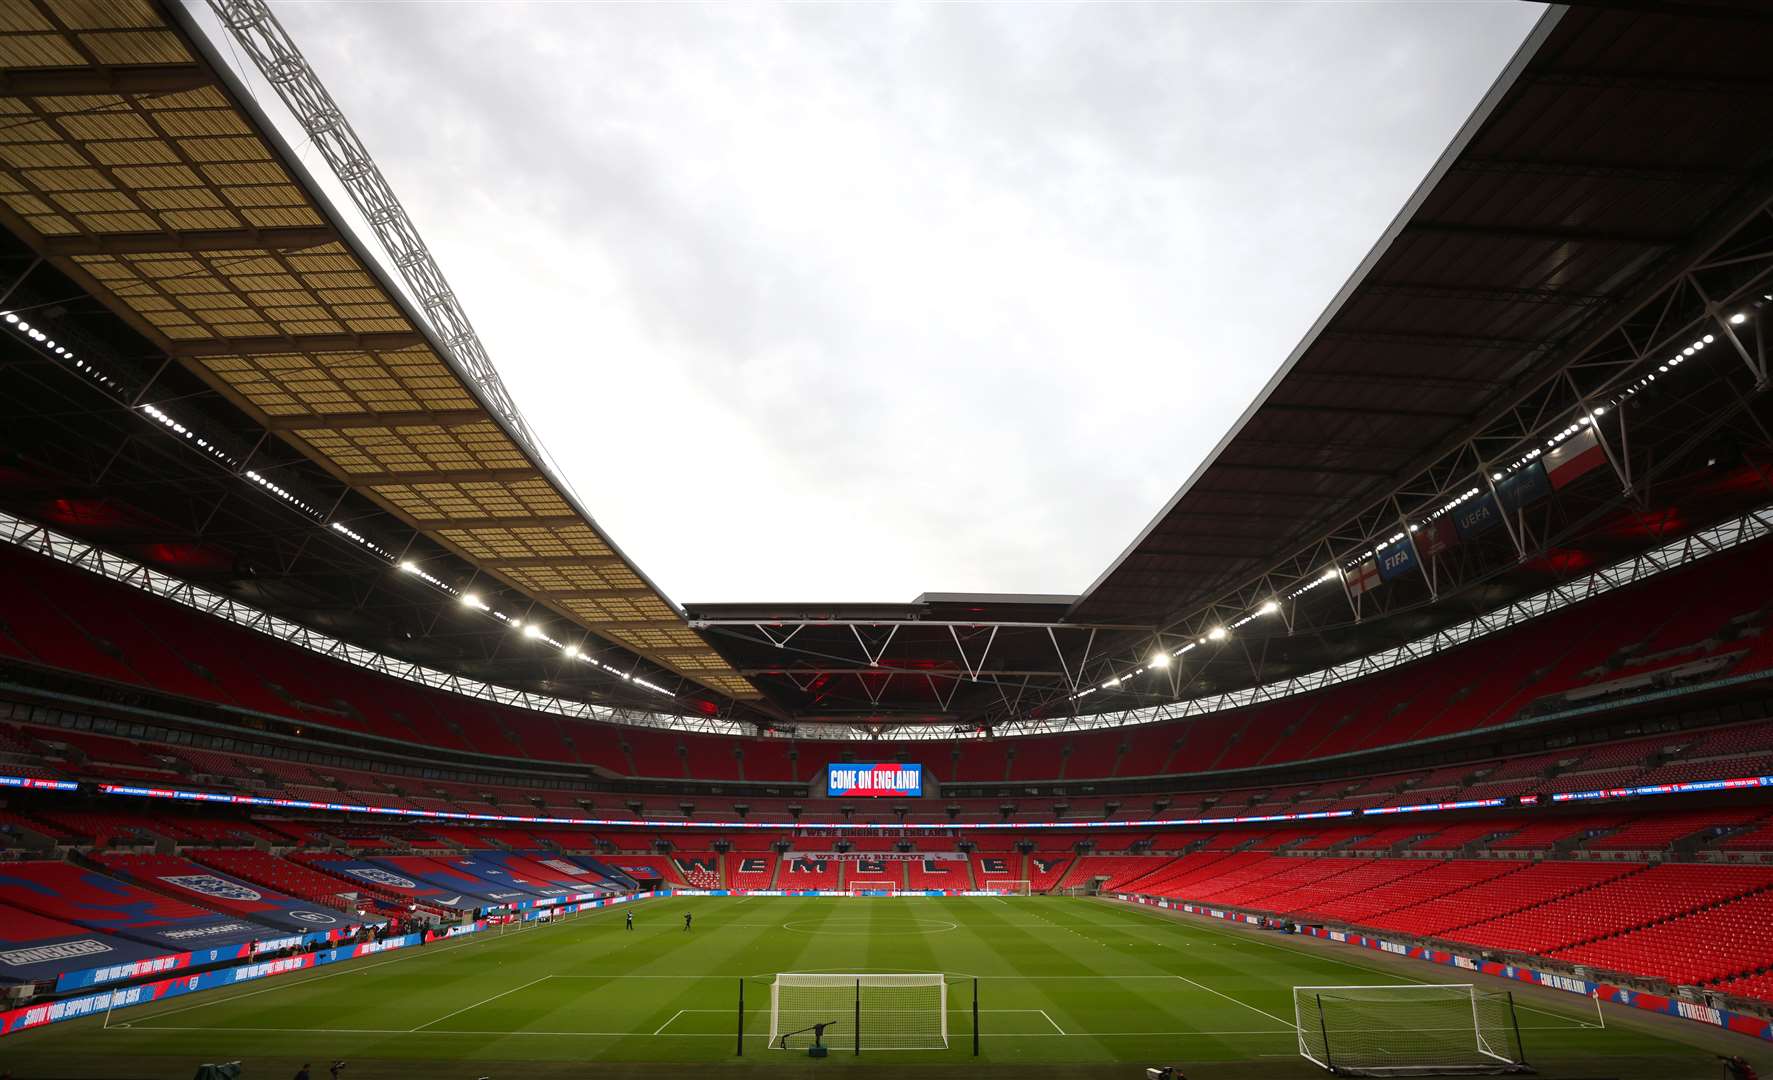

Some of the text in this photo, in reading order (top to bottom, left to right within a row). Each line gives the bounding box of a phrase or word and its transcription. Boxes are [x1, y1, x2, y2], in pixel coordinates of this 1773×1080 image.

[1461, 506, 1490, 529] UEFA
[1384, 551, 1409, 571] FIFA
[831, 770, 919, 789] COME ON ENGLAND!
[815, 853, 925, 861] WE STILL BELIEVE
[1, 941, 107, 964] SNICKERS
[94, 967, 110, 983] SHOW
[108, 965, 121, 979] YOUR
[121, 962, 142, 977] SUPPORT
[235, 967, 249, 980] SHOW
[248, 965, 259, 977] YOUR
[258, 962, 275, 975] SUPPORT
[1540, 972, 1554, 987] COME
[1553, 975, 1562, 989] ON
[24, 1006, 48, 1025] SHOW
[46, 1002, 66, 1021] YOUR
[64, 997, 95, 1016] SUPPORT
[93, 993, 111, 1011] FROM
[1677, 1001, 1722, 1026] #THREELIONS
